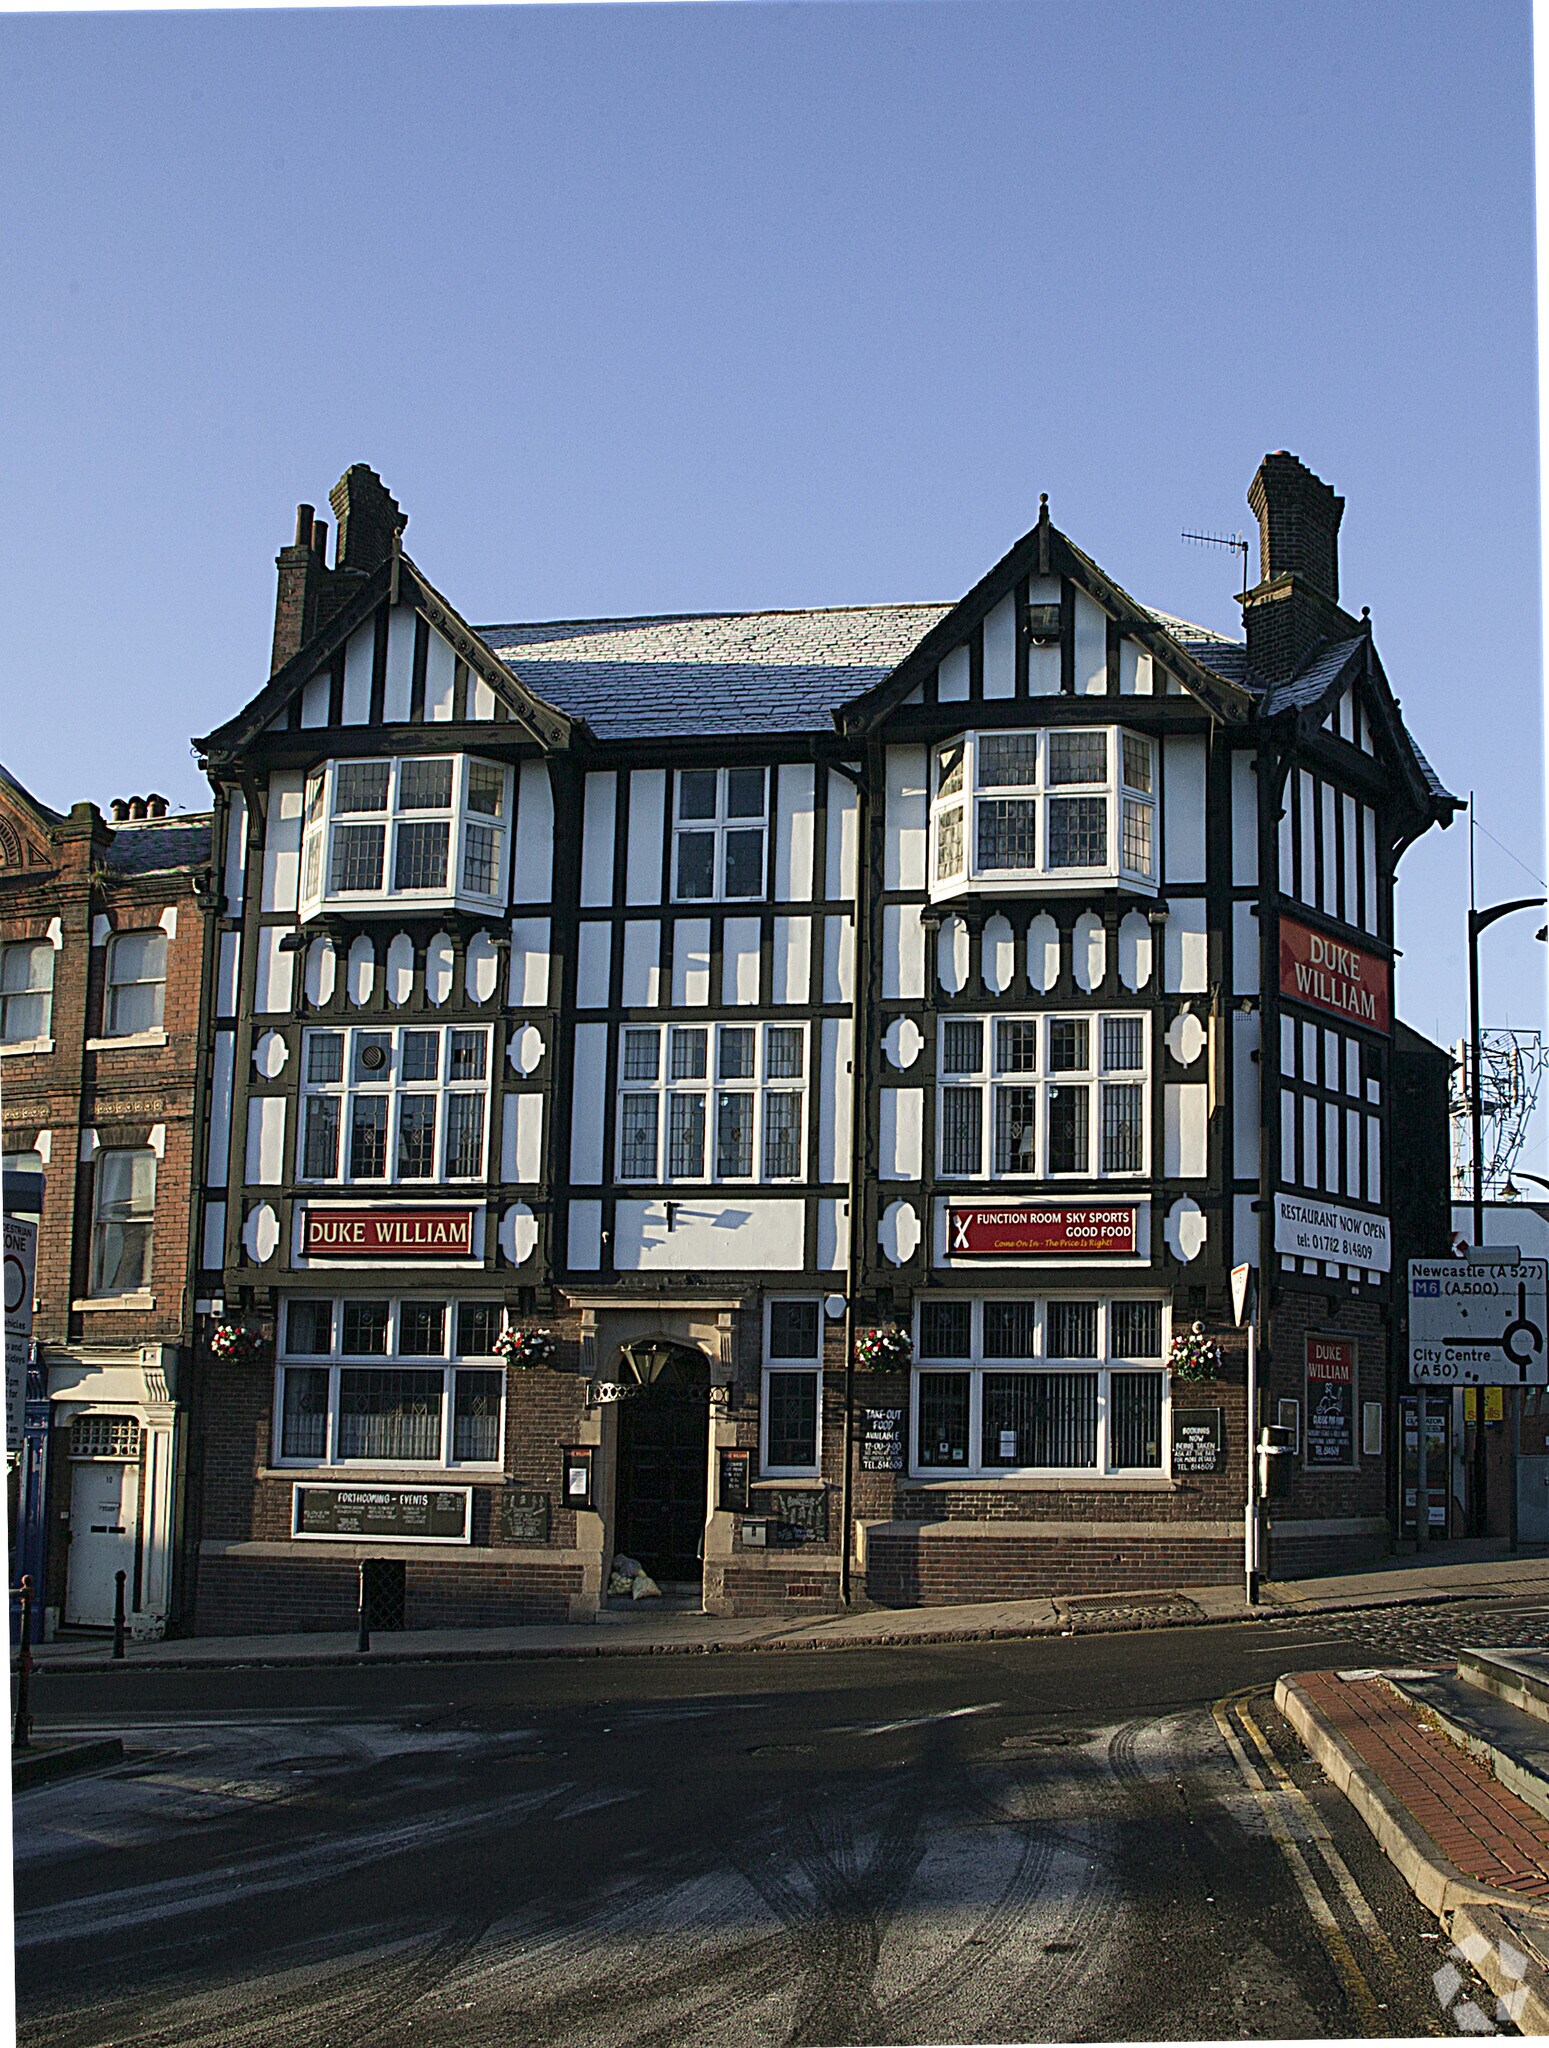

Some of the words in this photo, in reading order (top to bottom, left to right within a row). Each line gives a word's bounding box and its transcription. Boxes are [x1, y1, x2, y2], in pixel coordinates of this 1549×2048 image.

[1310, 934, 1361, 981] DUKE
[1294, 961, 1376, 1020] WILLIAM
[977, 1213, 1027, 1224] FUNCTION
[1030, 1213, 1062, 1223] ROOM
[1066, 1213, 1086, 1223] SKY
[1089, 1212, 1129, 1223] SPORTS
[1281, 1203, 1338, 1228] RESTAURANT
[1340, 1216, 1362, 1234] NOW
[1363, 1222, 1386, 1239] OPEN
[309, 1223, 366, 1243] DUKE
[375, 1223, 467, 1243] WILLIAM
[1066, 1227, 1098, 1237] GOOD
[1101, 1226, 1131, 1237] FOOD
[994, 1240, 1015, 1248] Come
[1045, 1239, 1059, 1247] The
[1060, 1239, 1080, 1247] Price
[1081, 1239, 1088, 1247] Is
[1089, 1238, 1113, 1248] Right!
[1297, 1233, 1310, 1247] tel:
[1412, 1264, 1485, 1278] Newcastle
[1316, 1345, 1341, 1360] DUKE
[1413, 1348, 1441, 1363] City
[1445, 1348, 1491, 1361] Centre
[1309, 1363, 1349, 1380] WILLIAM
[865, 1409, 902, 1420] TAKE-OUT
[873, 1420, 894, 1430] FOOD
[1182, 1427, 1210, 1435] BOOKINGS
[865, 1431, 900, 1440] AVAILABLE
[337, 1492, 390, 1504] FORTHCOMING
[400, 1494, 428, 1506] EVENTS
